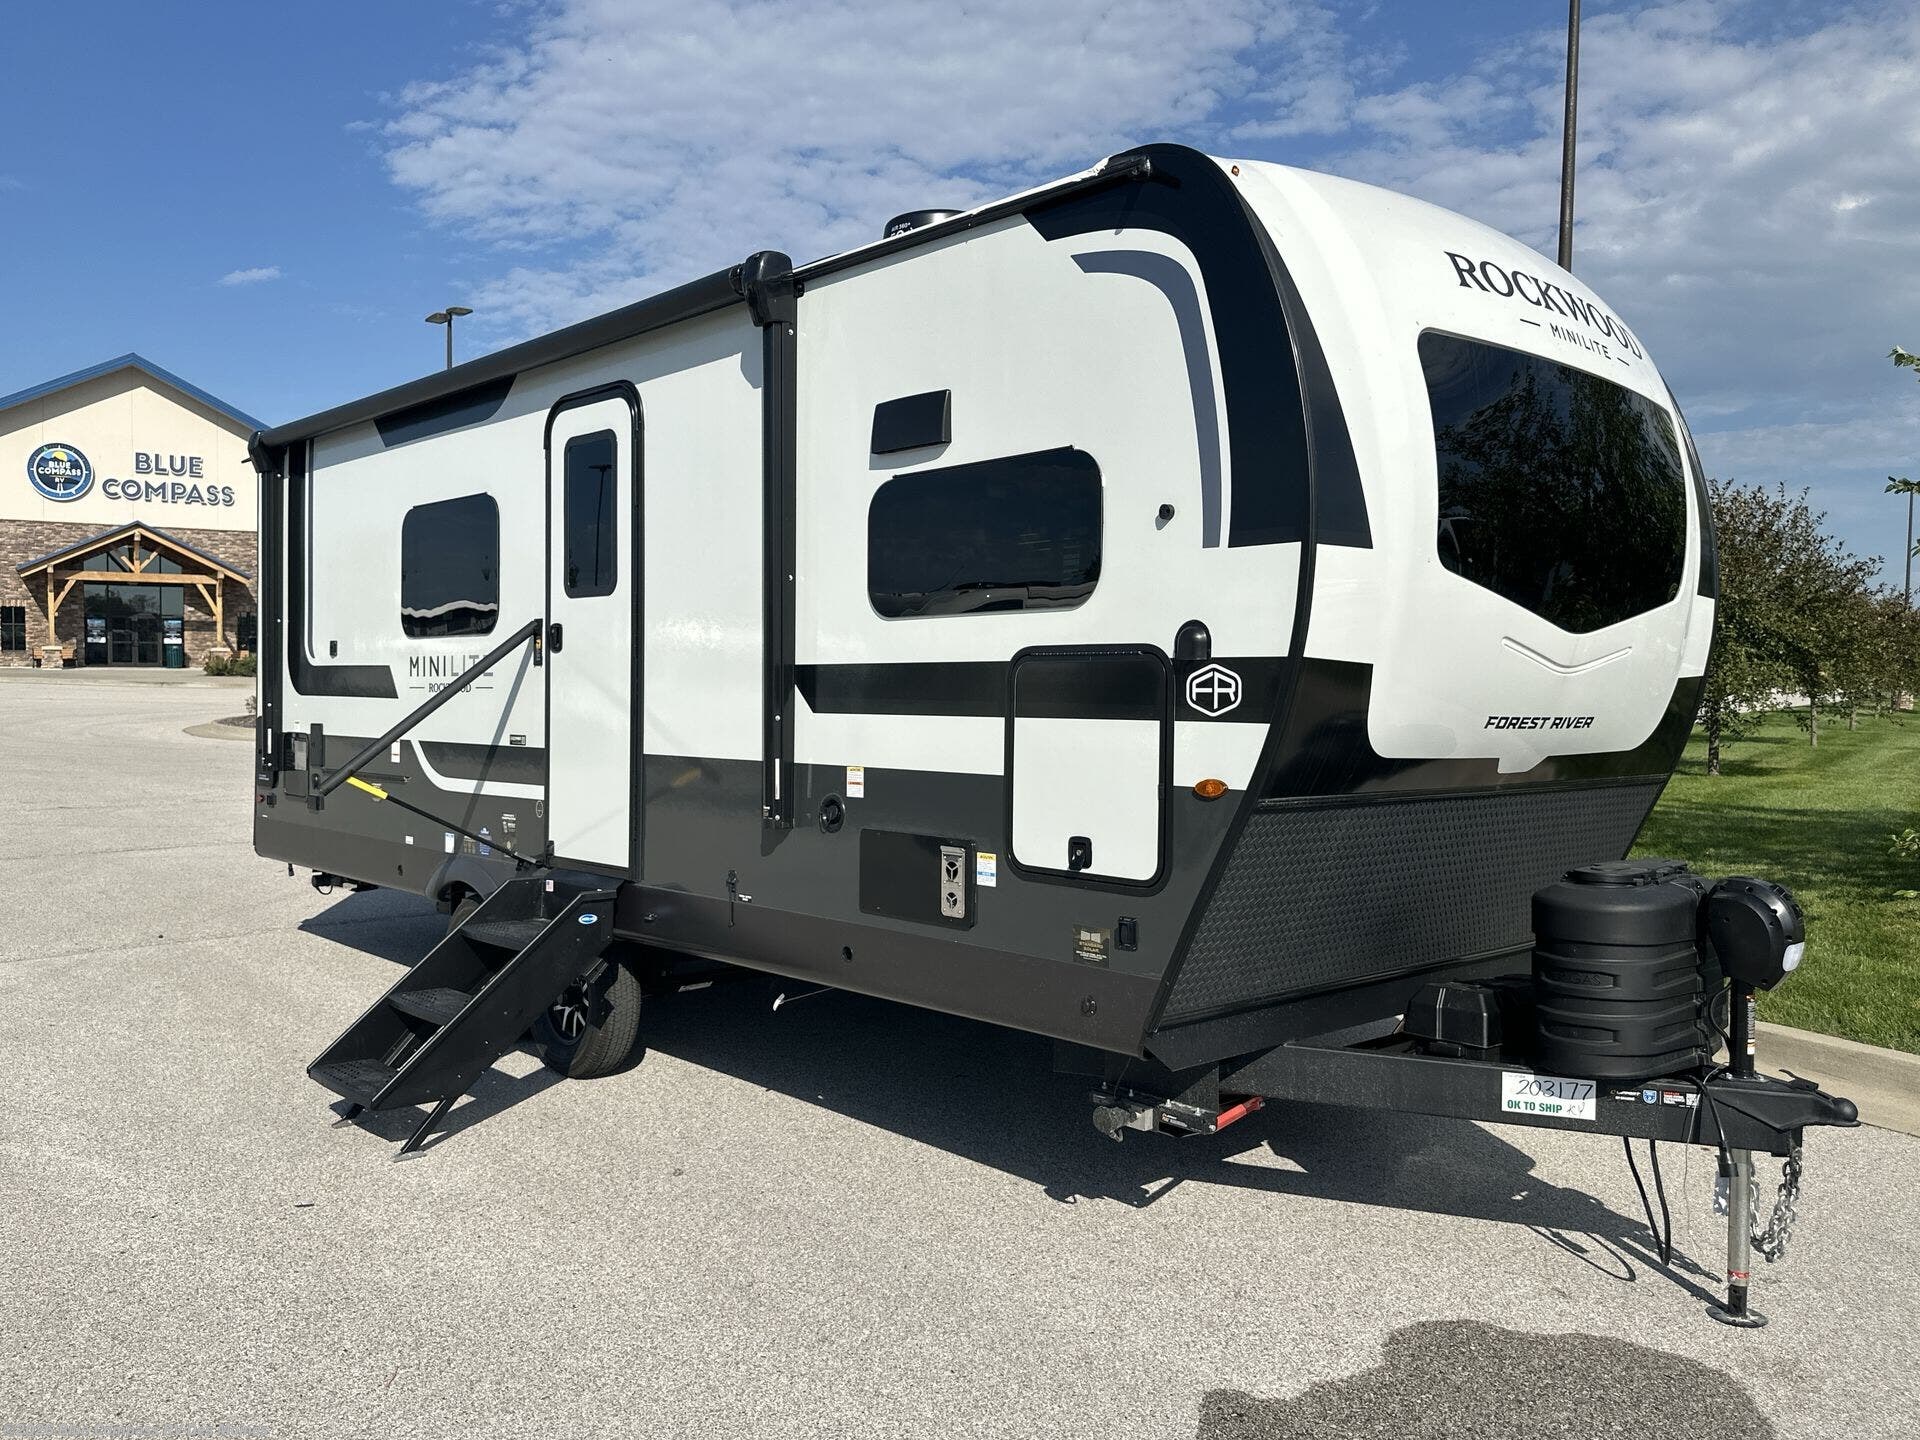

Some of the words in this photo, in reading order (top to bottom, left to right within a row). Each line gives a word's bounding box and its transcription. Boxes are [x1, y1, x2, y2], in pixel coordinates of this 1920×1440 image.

[1443, 251, 1643, 360] ROCKWOOD
[1550, 323, 1611, 360] MINILITE
[38, 466, 81, 476] COMPASS
[48, 460, 71, 469] BLUE
[135, 452, 203, 478] BLUE
[102, 478, 235, 506] COMPASS
[1484, 716, 1551, 729] FOREST
[1549, 716, 1595, 729] RIVER
[1516, 1080, 1594, 1101] 203177
[1507, 1100, 1521, 1109] OK
[1523, 1101, 1536, 1111] TO
[1538, 1102, 1563, 1113] SHIP
